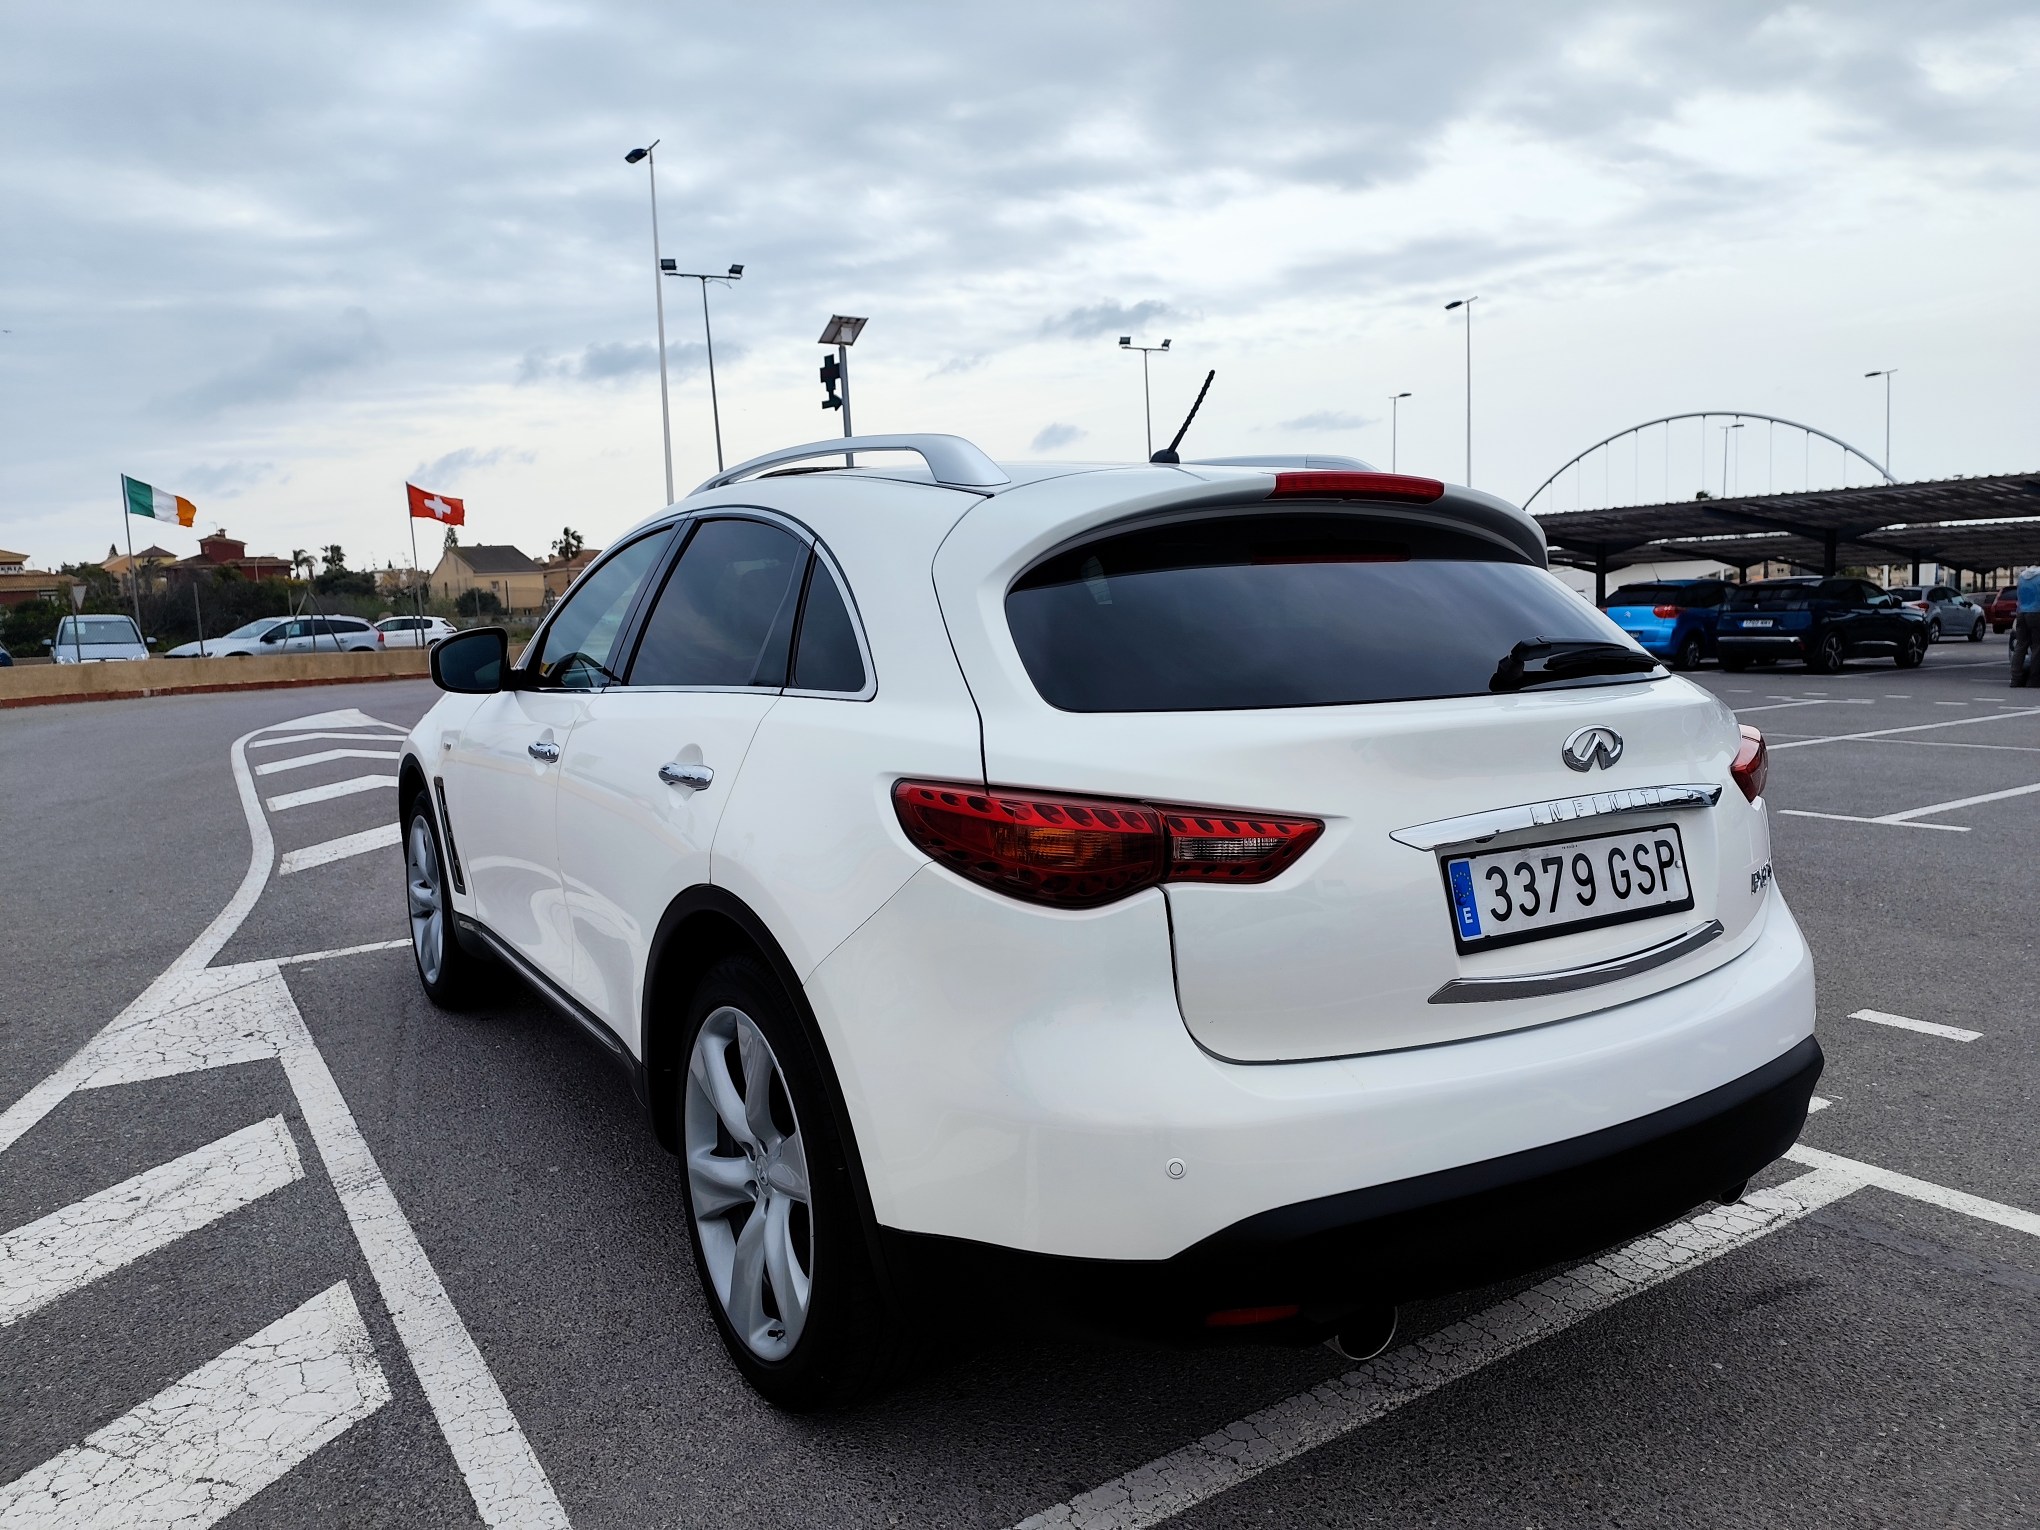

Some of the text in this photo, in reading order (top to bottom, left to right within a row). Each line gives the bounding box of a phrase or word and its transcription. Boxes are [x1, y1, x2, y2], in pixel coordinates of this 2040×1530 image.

[1529, 788, 1664, 826] INFINITI
[1485, 852, 1597, 922] 3379
[1607, 839, 1675, 900] GSP
[1462, 906, 1474, 924] E
